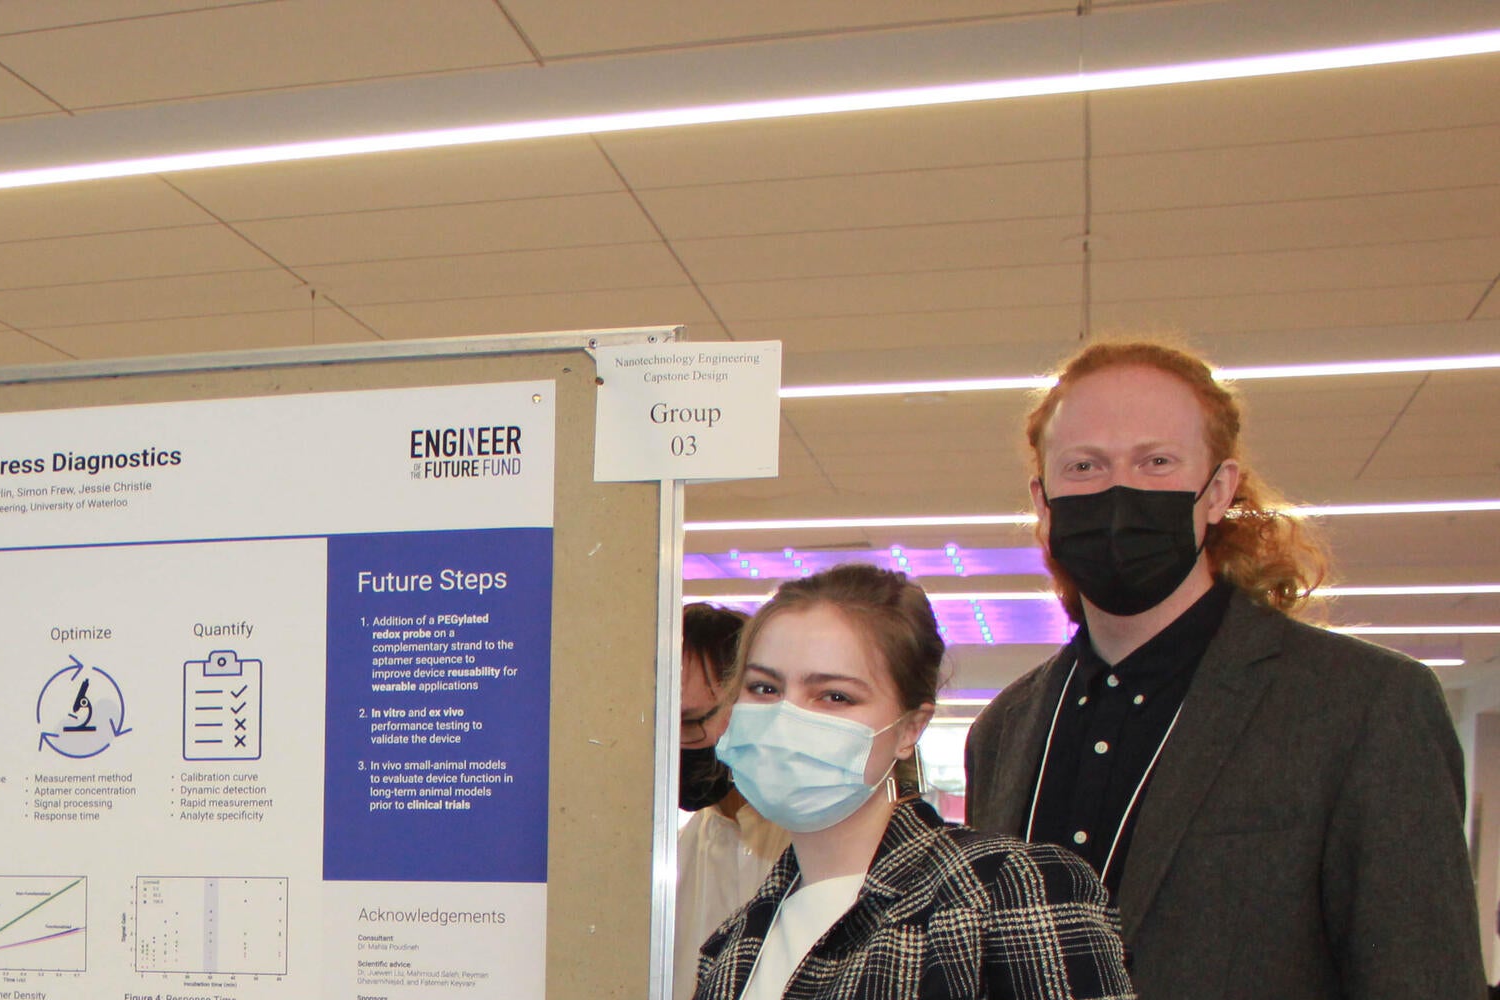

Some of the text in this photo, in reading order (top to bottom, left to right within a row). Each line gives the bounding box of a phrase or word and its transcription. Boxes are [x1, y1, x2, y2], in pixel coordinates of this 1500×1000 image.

[615, 353, 760, 368] Nanotechnology Engineering
[643, 370, 729, 384] Capstone Design
[650, 403, 722, 428] Group
[410, 426, 522, 458] ENGINEER
[670, 435, 698, 456] 03
[52, 448, 182, 474] Diagnostics
[414, 463, 421, 472] OF
[424, 458, 521, 478] FUTURE FUND
[410, 472, 420, 480] THE
[17, 488, 48, 497] Simon
[50, 486, 76, 495] Frew,
[78, 484, 111, 494] Jessie
[113, 482, 152, 492] Christie
[30, 502, 74, 511] University
[76, 499, 86, 509] of
[87, 498, 128, 508] Waterloo
[358, 570, 507, 593] Future Steps
[360, 617, 369, 627] 1.
[372, 616, 414, 626] Addition
[416, 615, 427, 625] of
[437, 614, 489, 626] PEGylated
[50, 627, 112, 642] Optimize
[193, 622, 254, 638] Quantify
[372, 630, 401, 639] redox
[403, 629, 432, 640] probe
[372, 640, 514, 653] complementary strand to the
[372, 655, 476, 667] aptamer sequence to
[372, 666, 518, 680] improve device reusability for
[372, 681, 479, 692] wearable applications
[359, 708, 368, 718] 2.
[372, 708, 381, 718] In
[383, 708, 406, 718] vitro
[408, 707, 427, 717] and
[443, 707, 464, 717] vivo
[371, 721, 483, 732] performance testing to
[370, 734, 461, 744] validate the device
[358, 760, 506, 771] 3. In vivo small-animal models
[34, 773, 133, 783] Measurement method
[180, 773, 231, 782] Calibration
[370, 773, 513, 784] to evaluate device function in
[34, 787, 136, 796] Aptamer concentration
[180, 785, 267, 796] Dynamic detection
[34, 799, 113, 810] Signal processing
[180, 798, 206, 809] Rapid
[34, 812, 100, 821] Response time
[180, 811, 264, 822] Analyte specificity
[358, 908, 506, 925] Acknowledgements
